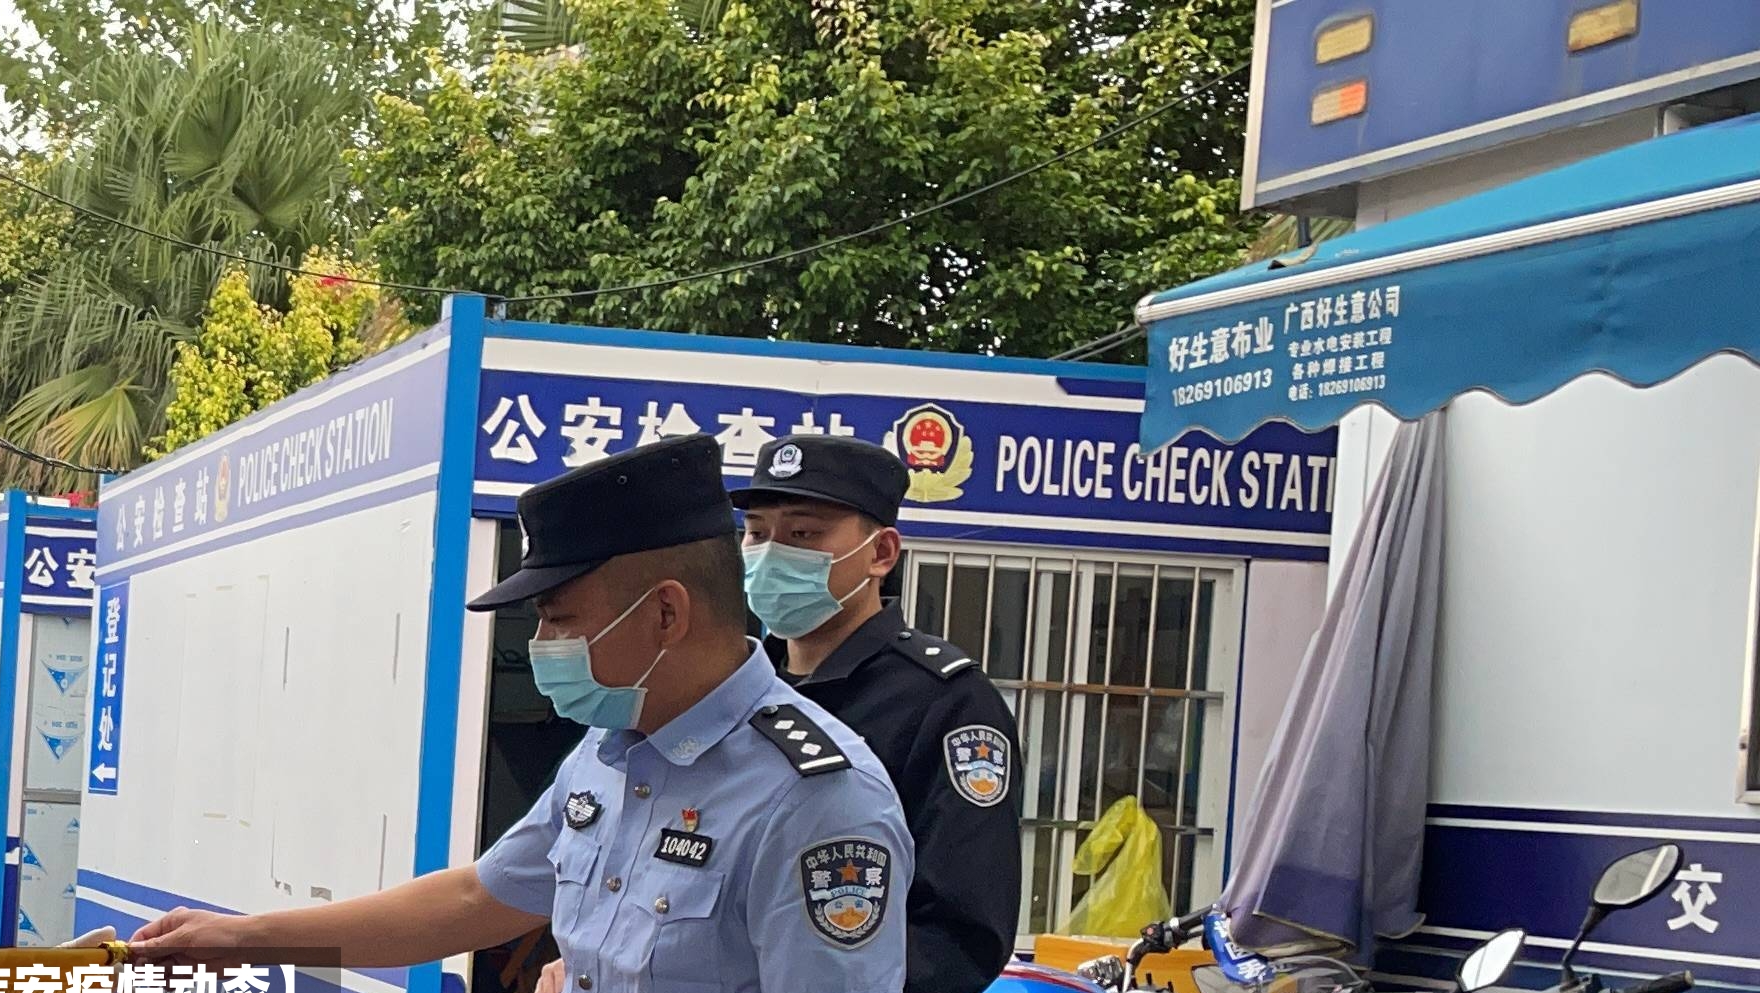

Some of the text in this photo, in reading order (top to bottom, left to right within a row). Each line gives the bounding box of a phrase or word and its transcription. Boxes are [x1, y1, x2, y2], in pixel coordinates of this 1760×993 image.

[1283, 285, 1400, 334] 广西好生意公司
[1168, 317, 1274, 373] 好生意布业
[1288, 326, 1392, 359] 专业水电安装工程
[1292, 351, 1385, 380] 各种焊接工程
[1172, 368, 1273, 407] 18269106913
[238, 398, 394, 507] POLICE CHECK STATION
[996, 435, 1116, 499] POLICE
[1122, 443, 1234, 507] CHECK
[116, 467, 209, 550] 公安检查站
[24, 546, 95, 590] 公安
[98, 597, 120, 751] 登记处
[661, 836, 707, 860] 104042
[1667, 864, 1723, 933] 交
